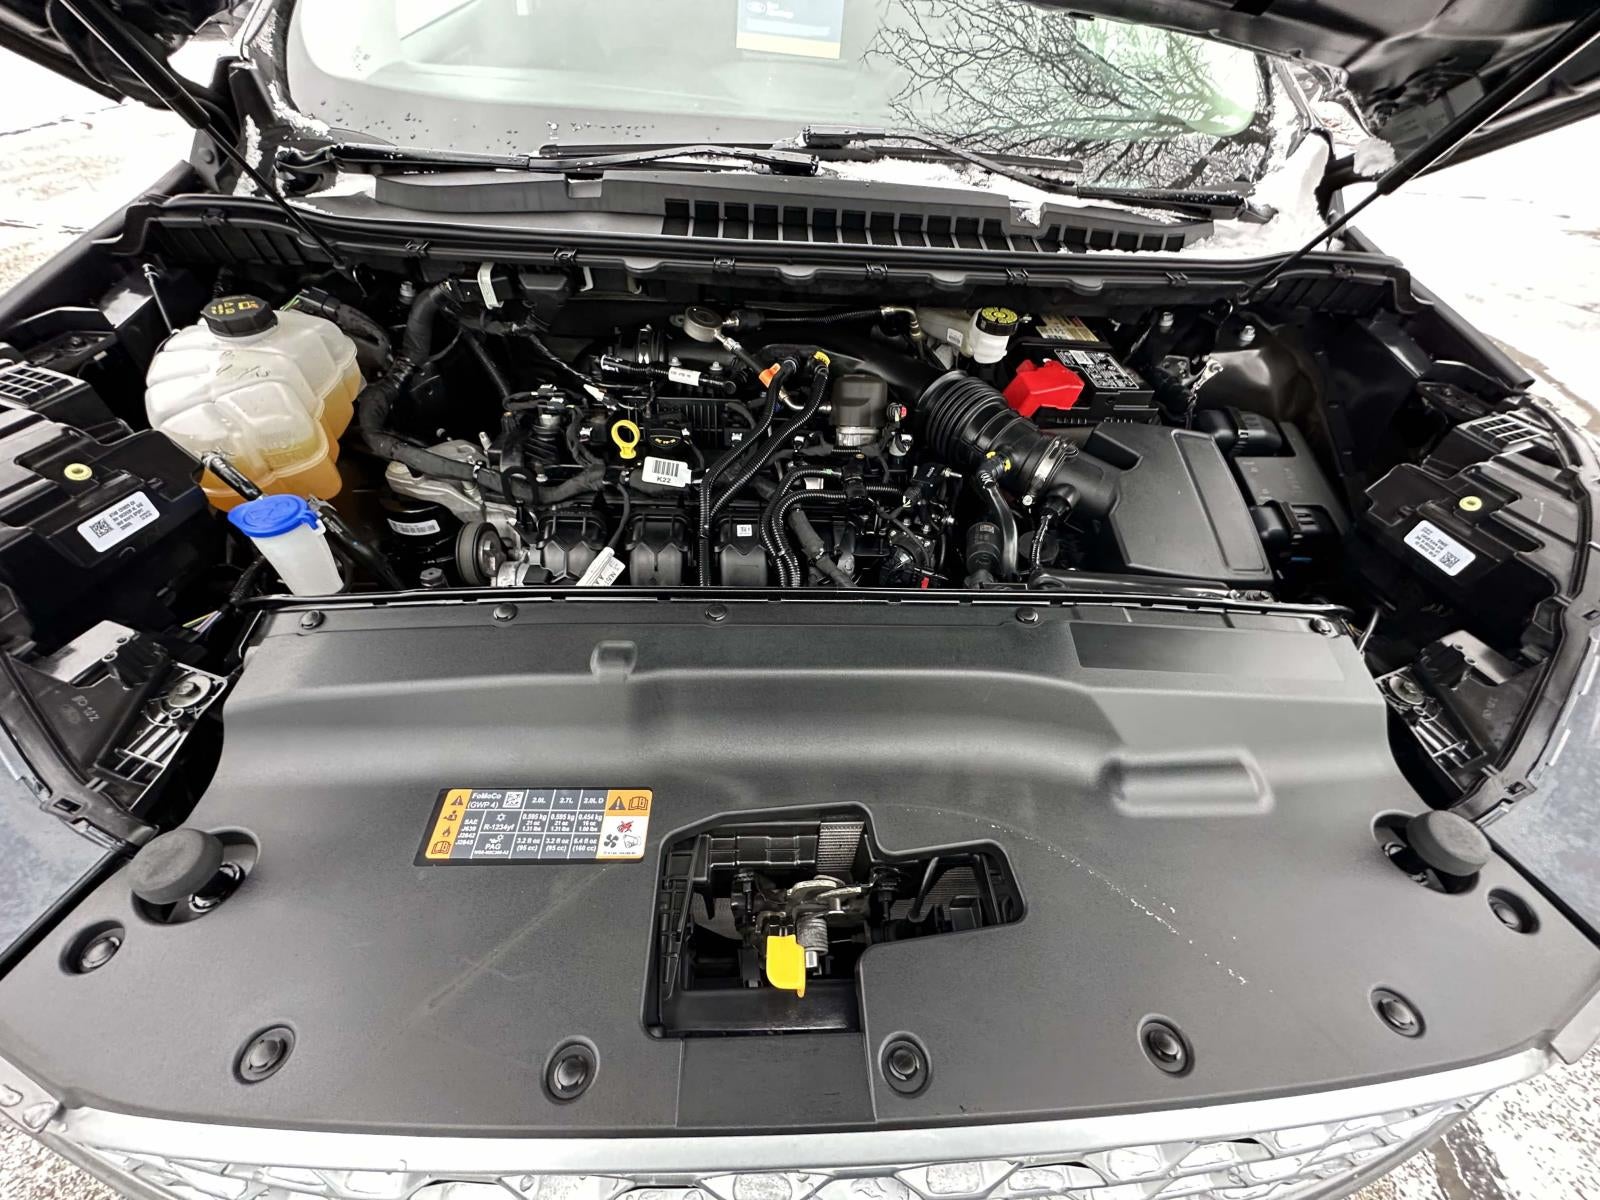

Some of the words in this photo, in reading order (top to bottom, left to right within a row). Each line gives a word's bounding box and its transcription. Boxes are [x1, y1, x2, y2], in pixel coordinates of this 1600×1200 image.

[467, 801, 490, 809] (GWP
[490, 801, 499, 809] 4)
[483, 824, 515, 832] R-1234yf
